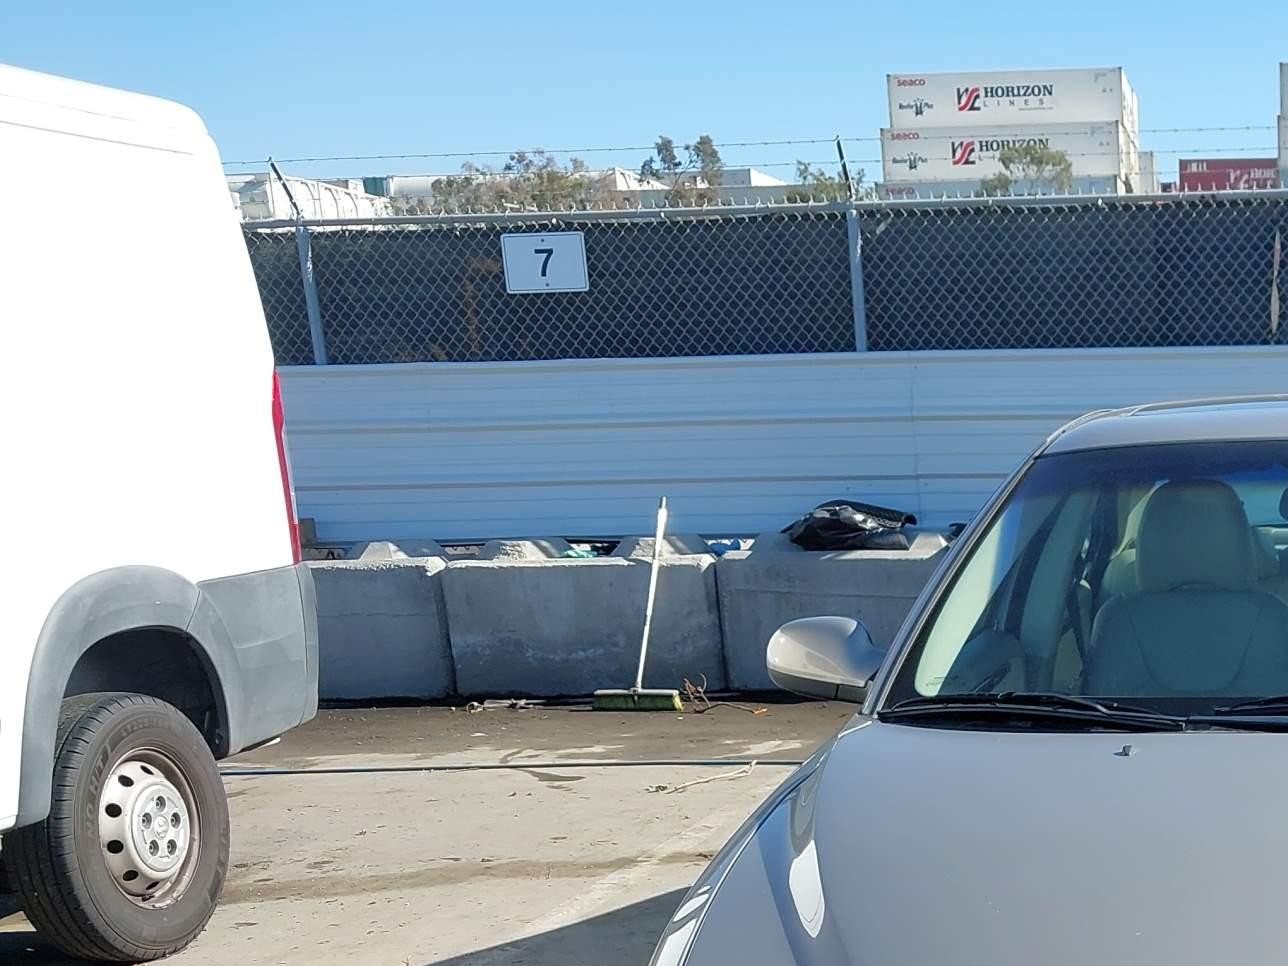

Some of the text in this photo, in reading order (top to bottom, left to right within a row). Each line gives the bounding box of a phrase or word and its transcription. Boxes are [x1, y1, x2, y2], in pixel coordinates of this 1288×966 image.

[896, 78, 926, 87] seaco
[984, 84, 1053, 98] HORIZON
[984, 98, 1044, 107] LINES
[890, 132, 920, 140] seaco
[978, 138, 1049, 152] HORIZON
[534, 248, 554, 277] 7
